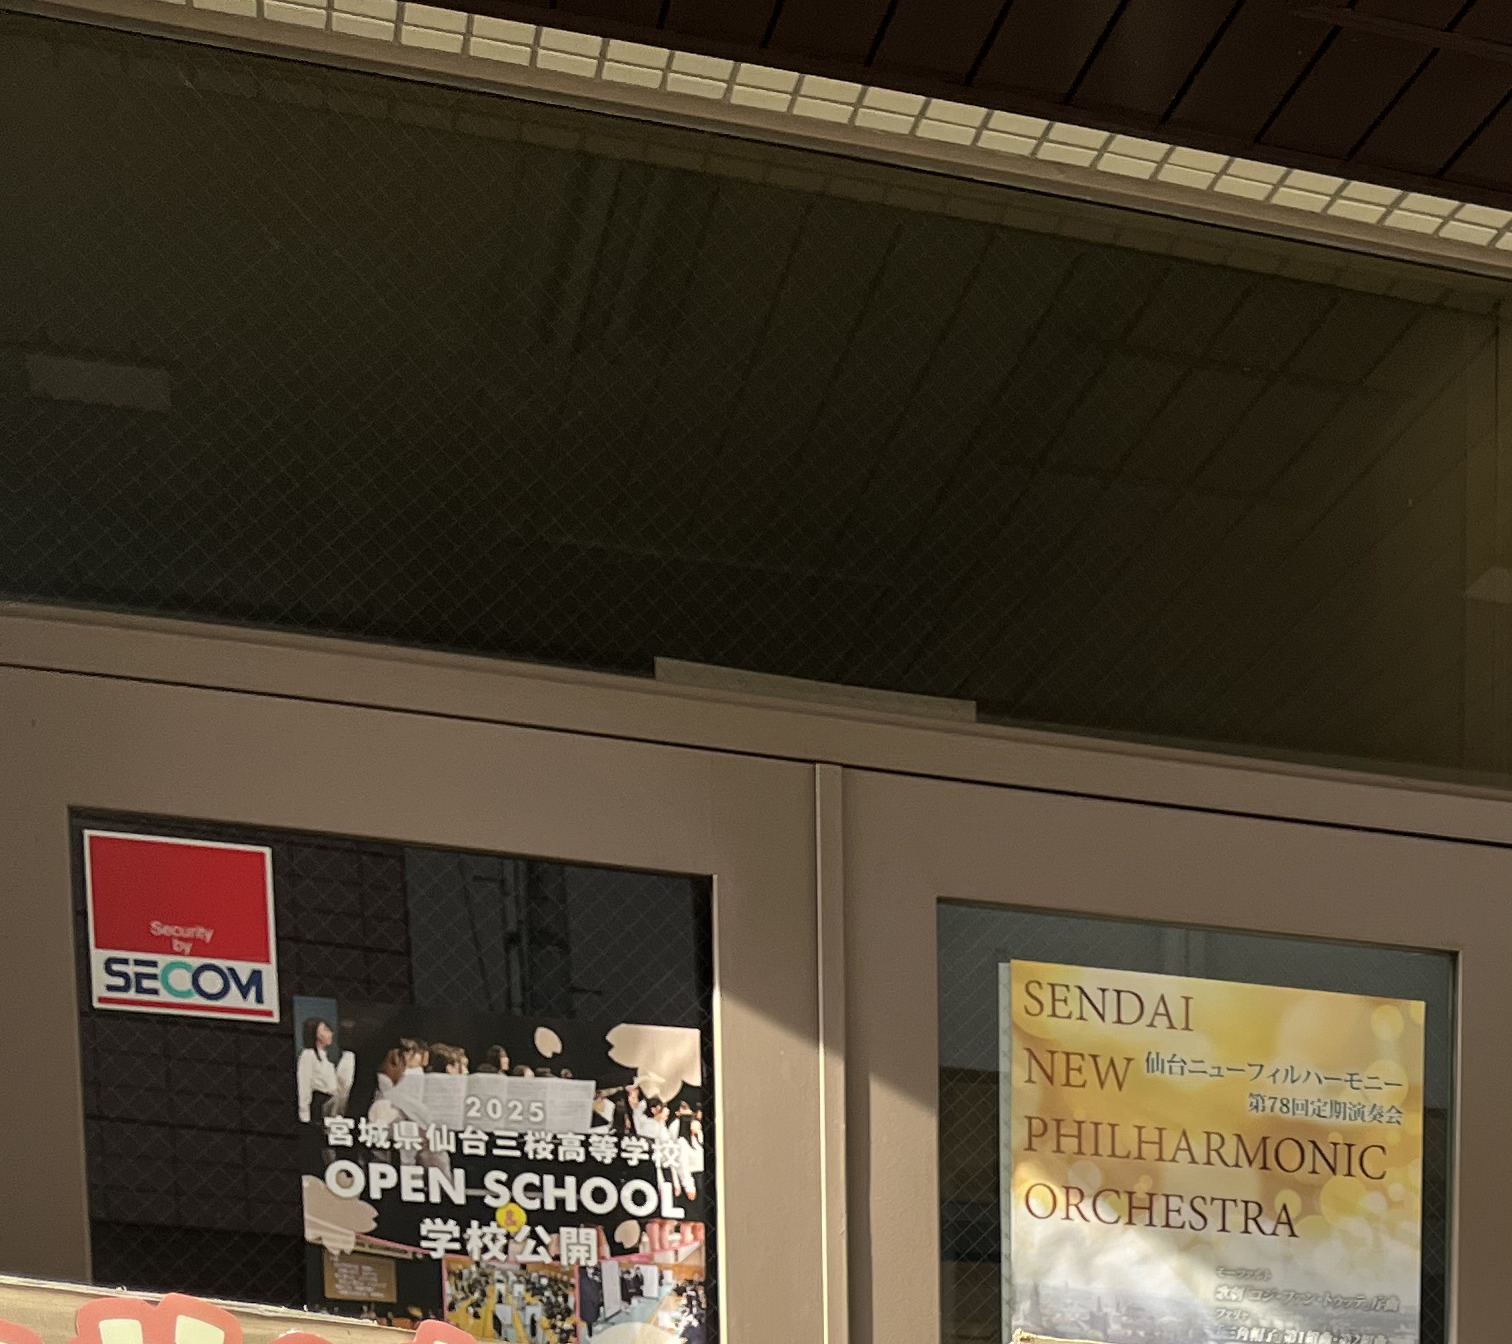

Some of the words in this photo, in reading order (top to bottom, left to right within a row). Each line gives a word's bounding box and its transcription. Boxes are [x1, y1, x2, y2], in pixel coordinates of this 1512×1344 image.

[149, 919, 214, 944] Security
[171, 938, 193, 955] by
[103, 956, 264, 1005] SECOM
[1023, 979, 1195, 1033] SENDAI
[1023, 1047, 1135, 1093] NEW
[1144, 1050, 1404, 1094] 仙台ニューフィルハーモニー
[465, 1094, 546, 1123] 2025
[1248, 1091, 1404, 1127] 第78回定期演奏会
[324, 1115, 684, 1169] 宮城県仙台三桜高等学校
[1023, 1114, 1388, 1181] PHILHARMONIC
[324, 1159, 468, 1207] OPEN
[483, 1169, 686, 1220] SCHOOL
[1024, 1183, 1300, 1239] ORCHESTRA
[419, 1218, 599, 1268] 学校公開
